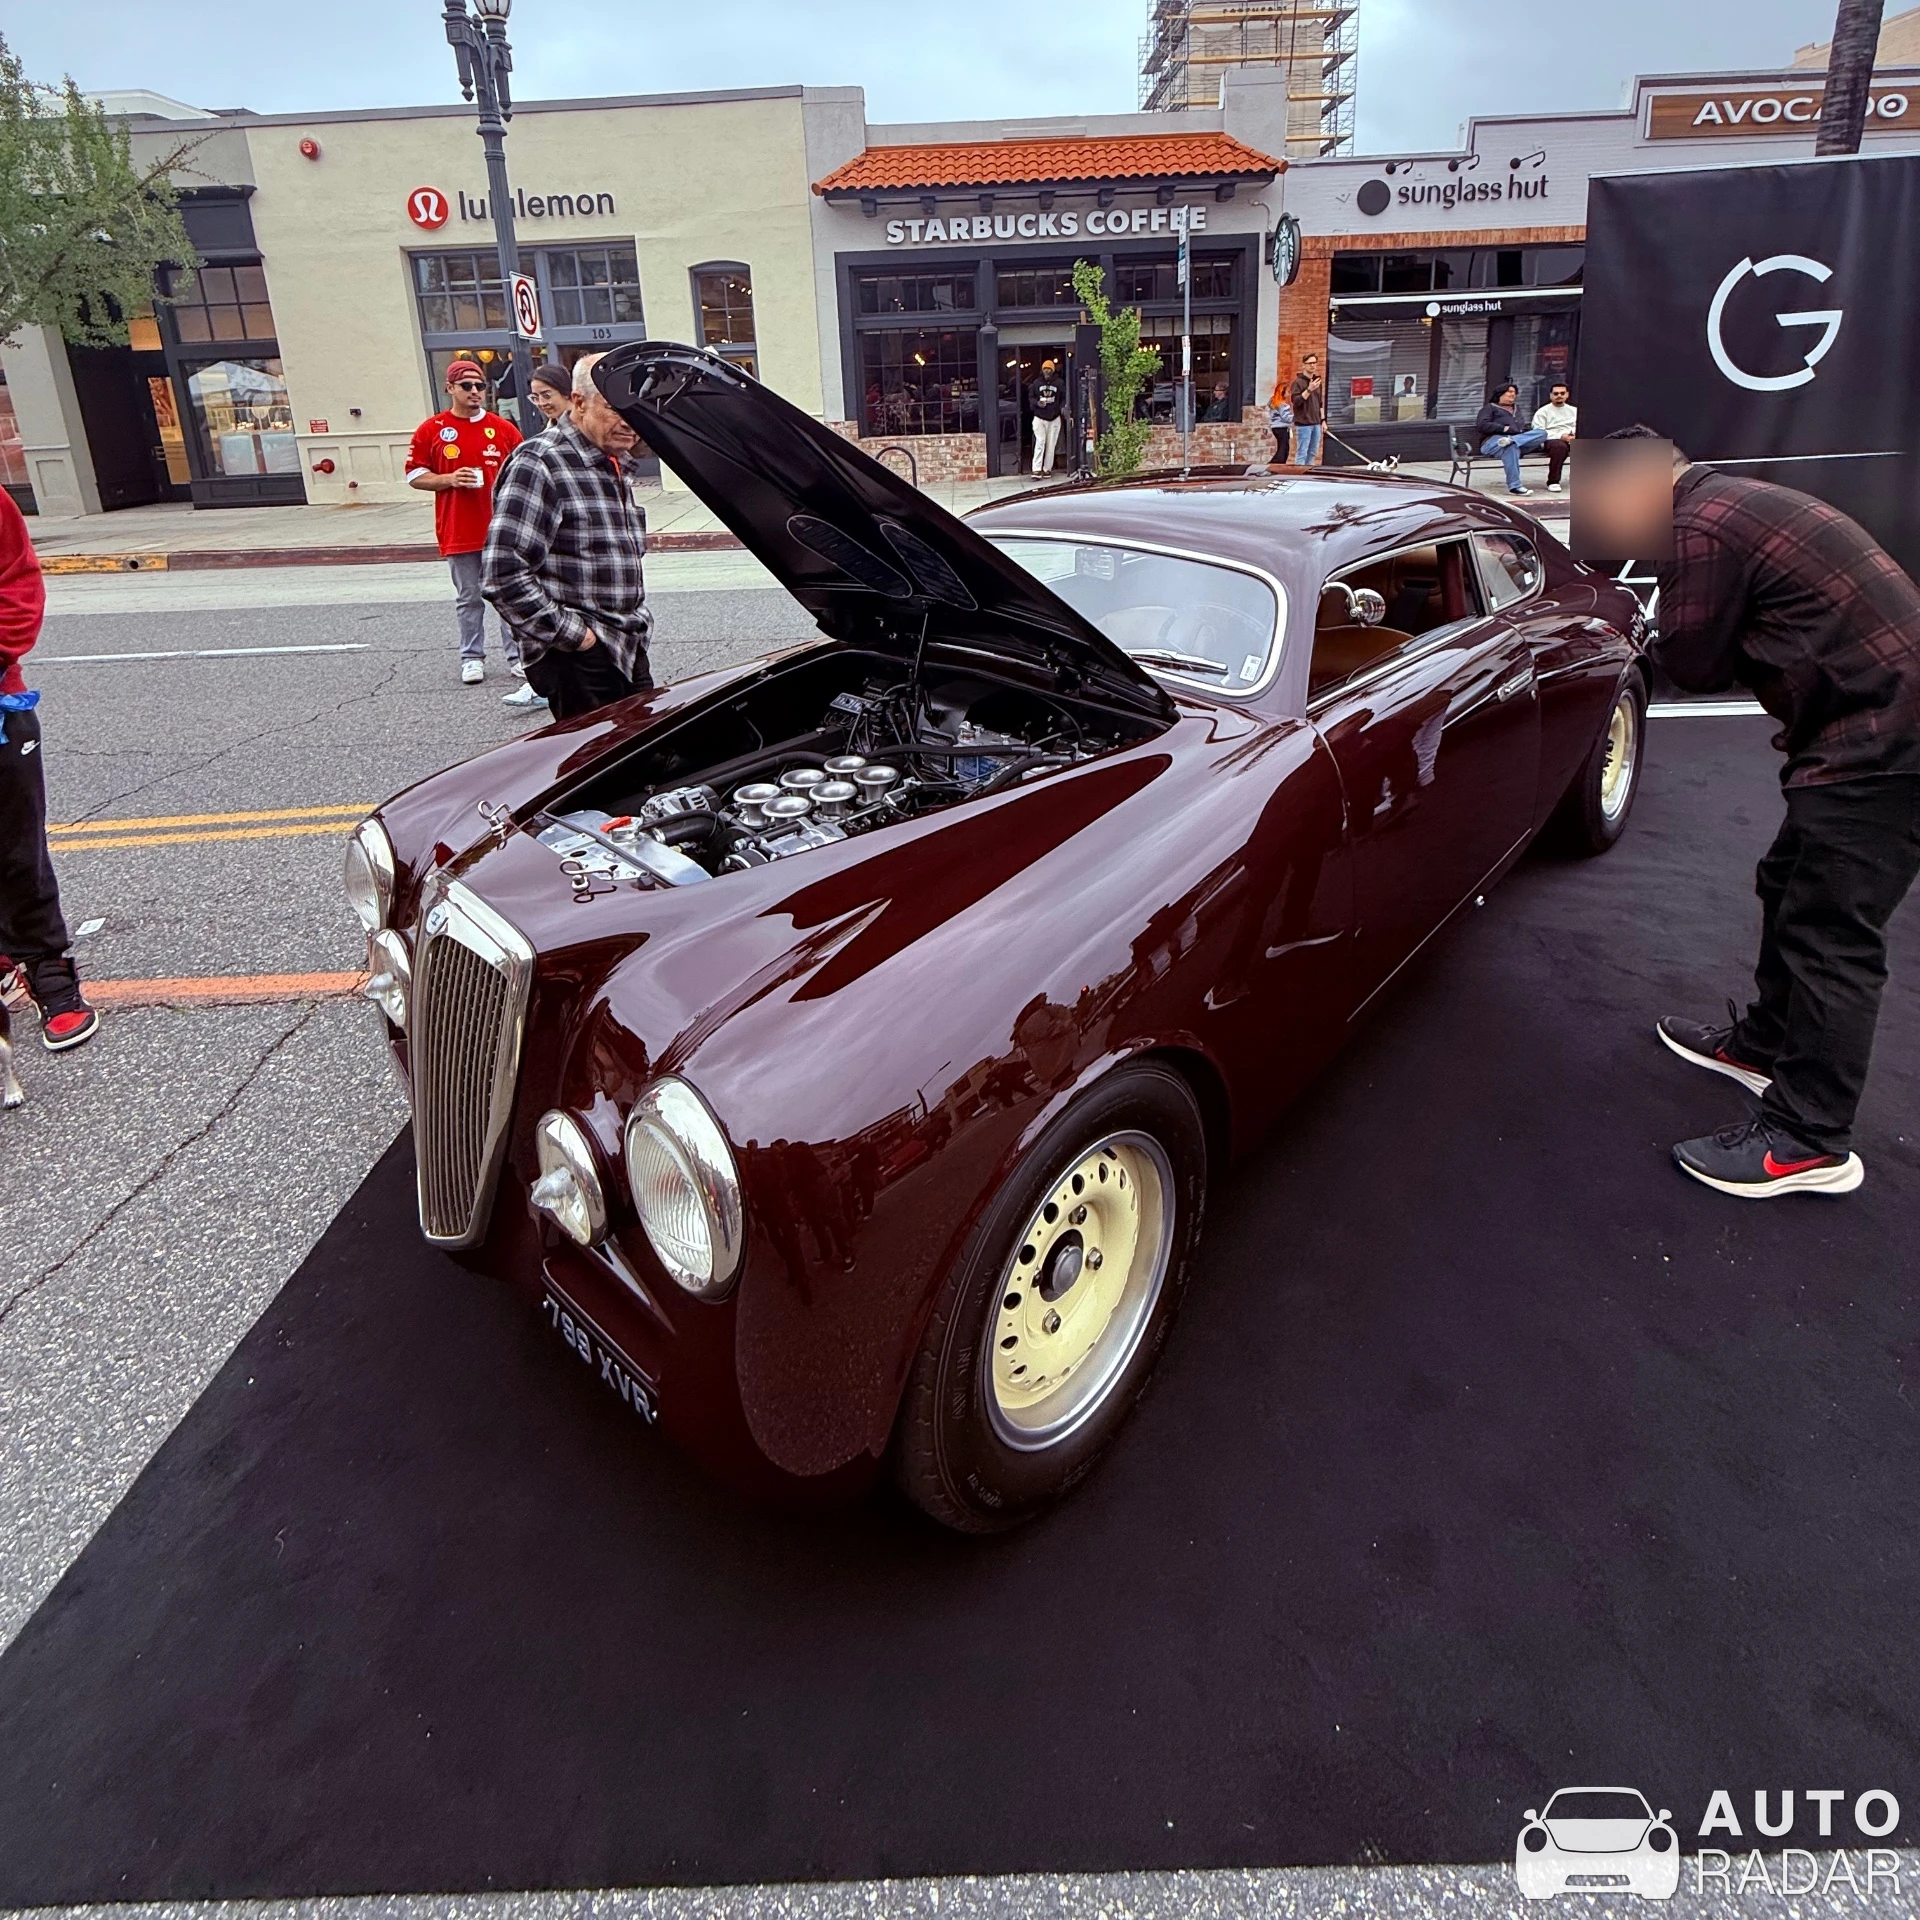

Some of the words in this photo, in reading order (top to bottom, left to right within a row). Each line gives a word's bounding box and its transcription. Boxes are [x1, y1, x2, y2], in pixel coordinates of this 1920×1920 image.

[1693, 93, 1909, 126] AVOCO
[1398, 176, 1502, 209] sunglass
[1508, 173, 1549, 199] hut
[886, 211, 1079, 244] STARBUCKS
[1442, 301, 1484, 315] sunglass
[1485, 300, 1502, 311] hut
[1707, 254, 1843, 391] G
[592, 328, 612, 339] 103
[597, 1346, 653, 1424] XVR
